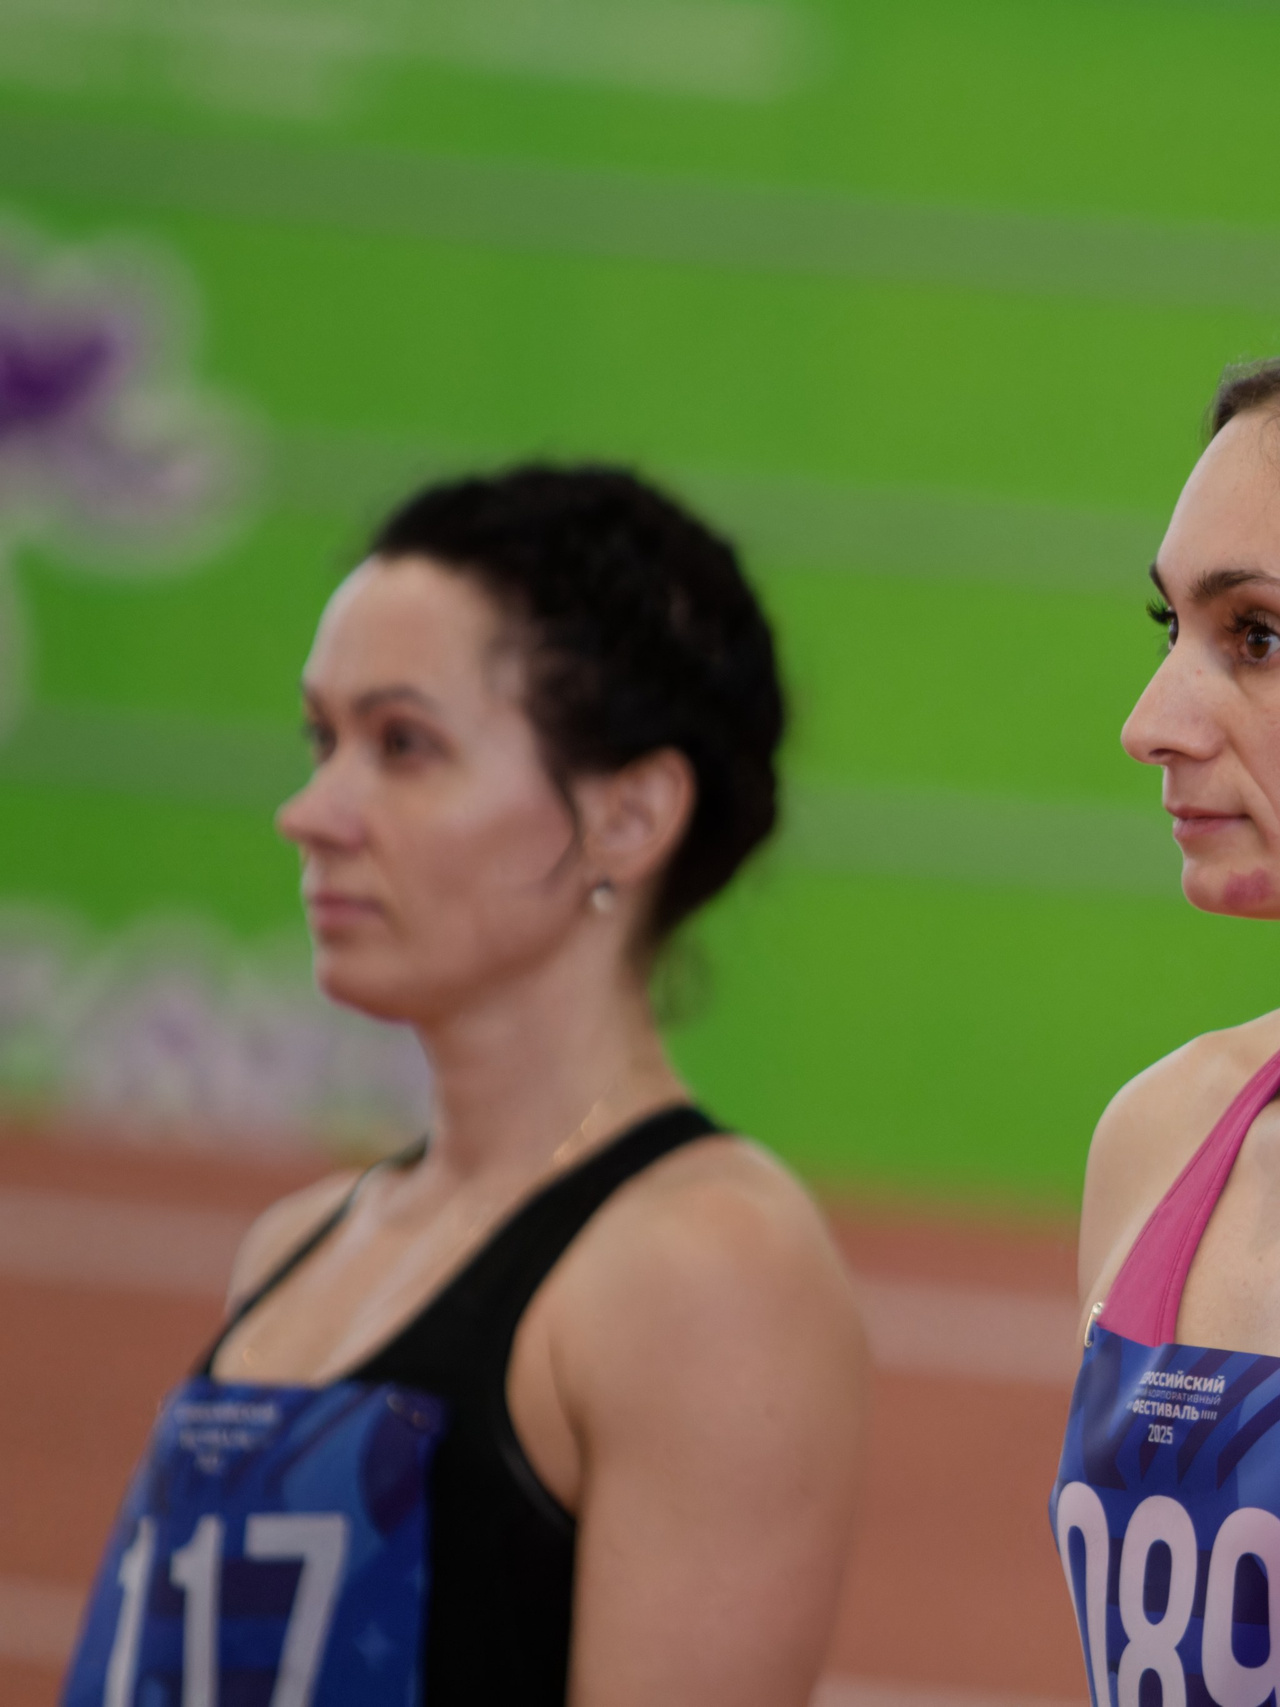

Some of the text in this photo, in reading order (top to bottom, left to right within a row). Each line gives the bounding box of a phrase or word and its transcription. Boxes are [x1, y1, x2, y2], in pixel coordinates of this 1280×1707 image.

[1132, 1398, 1200, 1421] ФЕСТИВАЛЬ
[1147, 1423, 1174, 1445] 2025
[103, 1511, 349, 1707] 117
